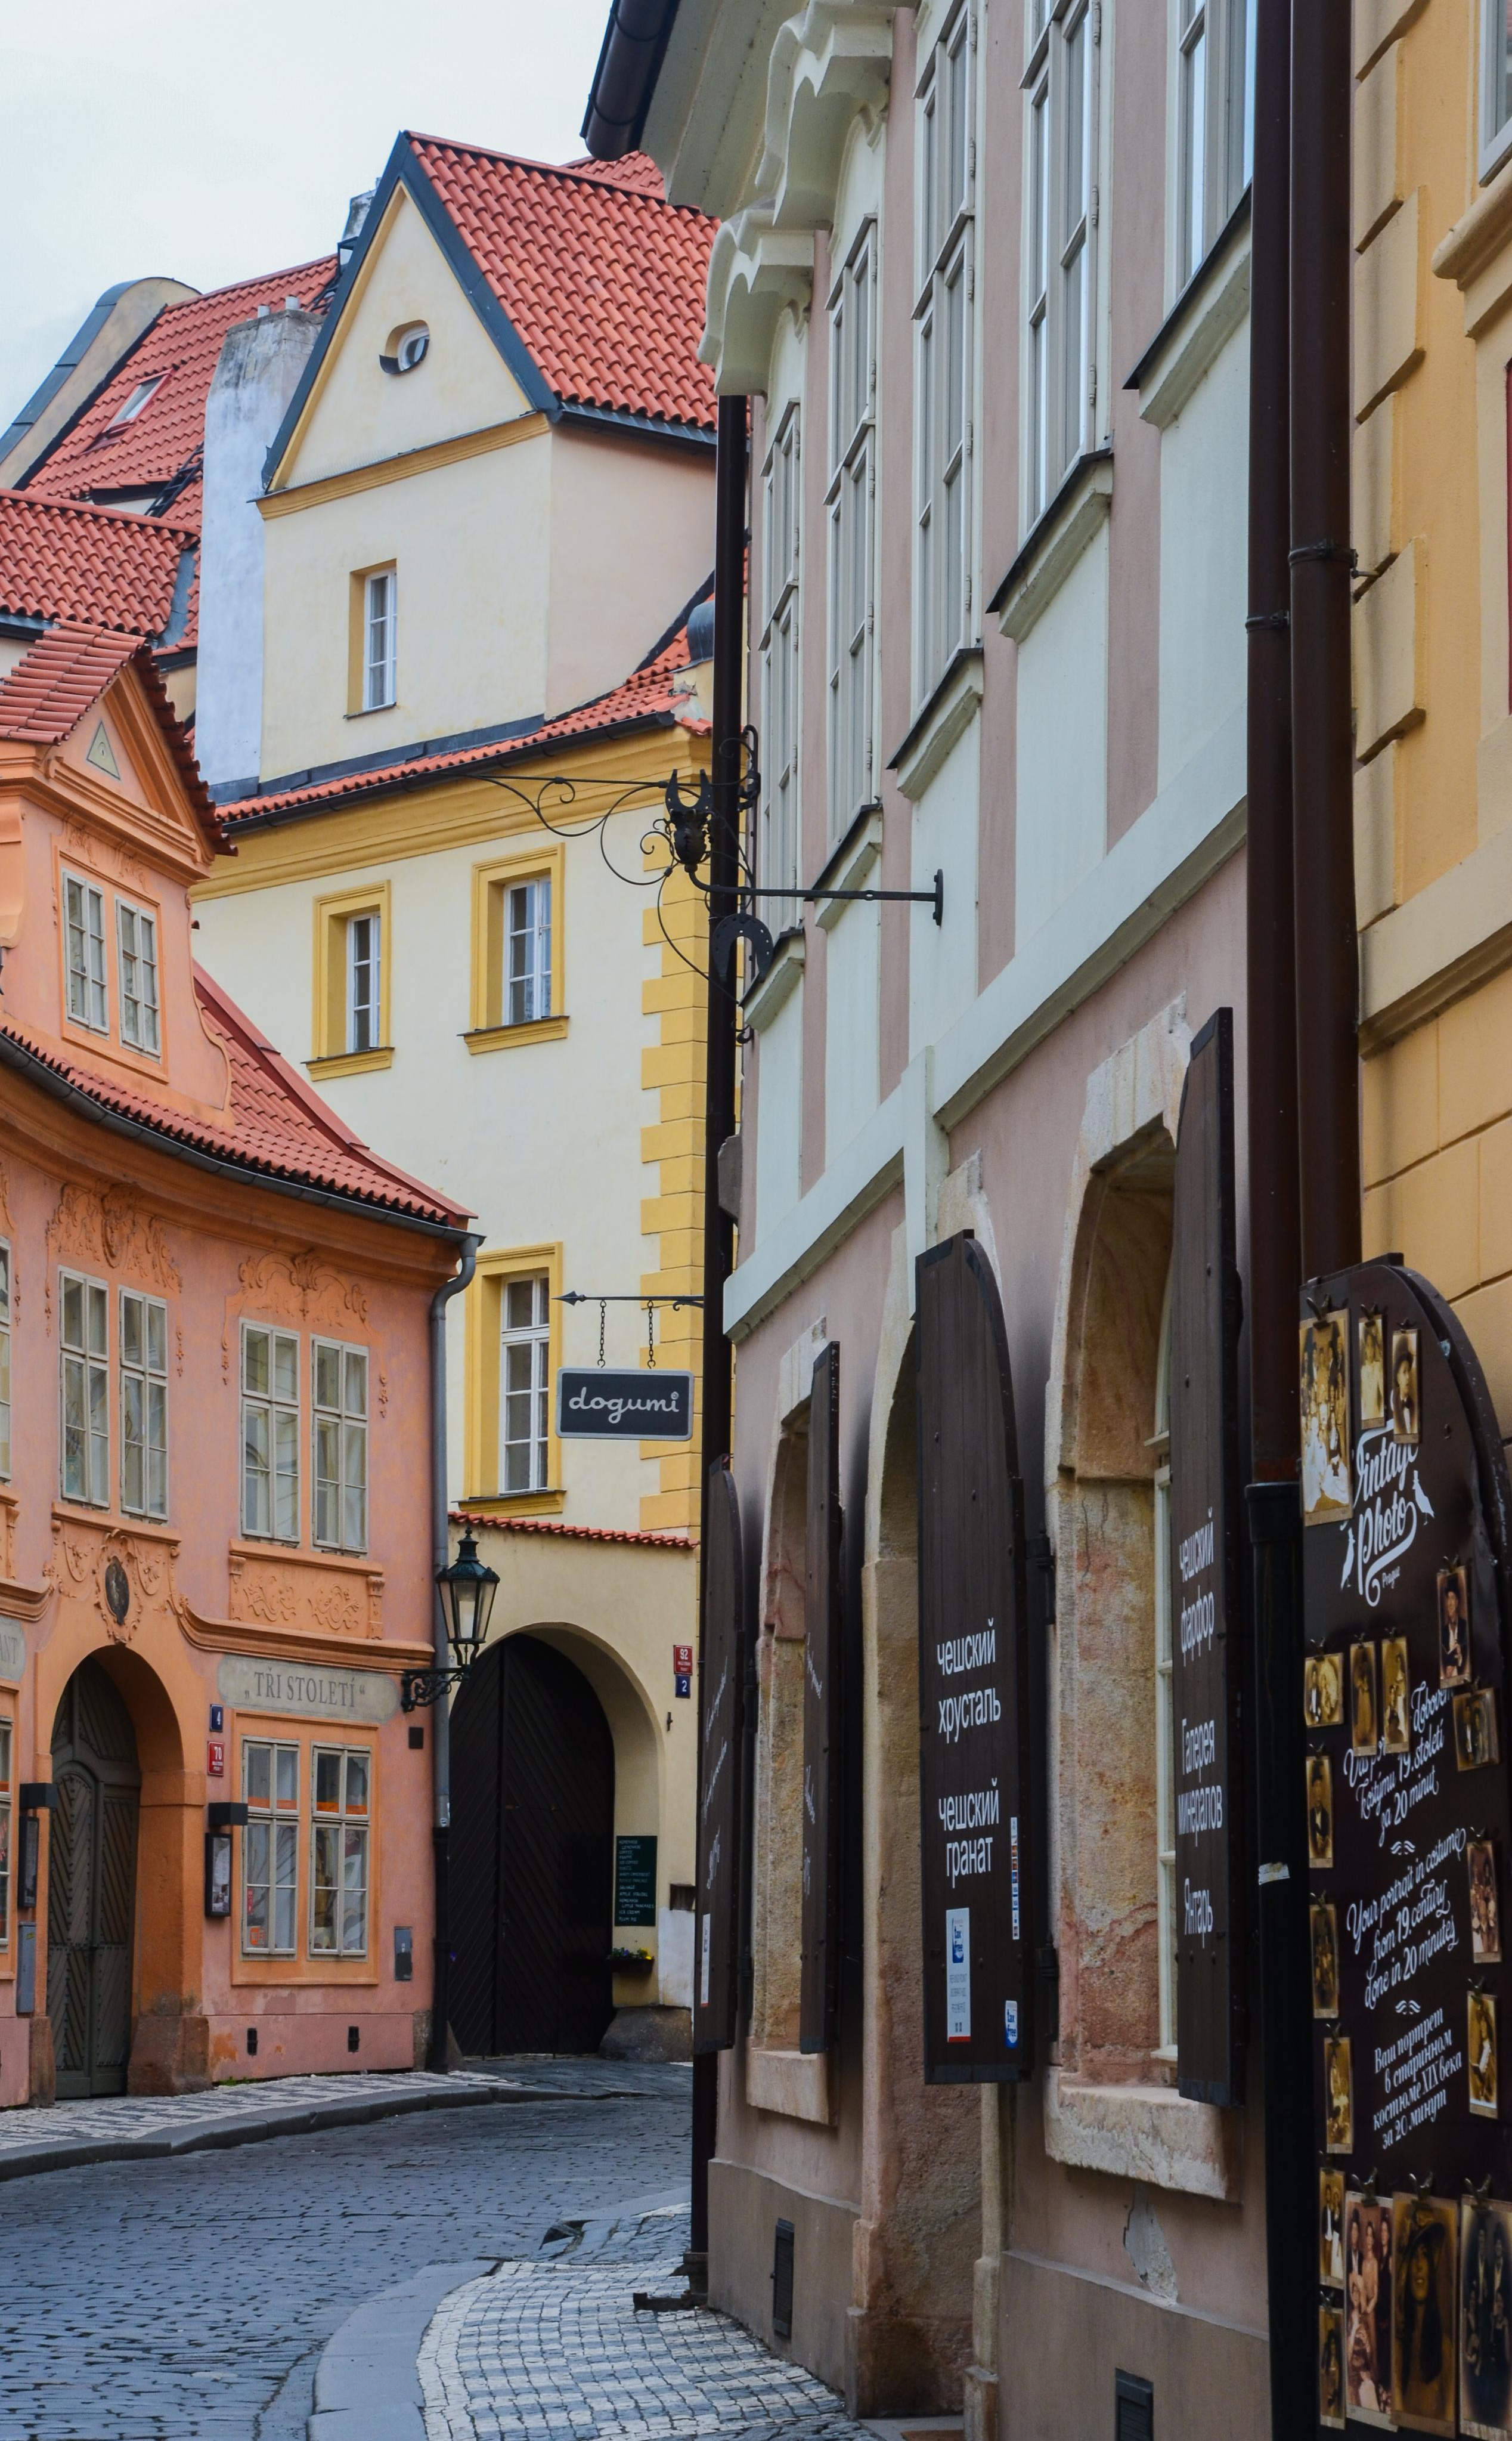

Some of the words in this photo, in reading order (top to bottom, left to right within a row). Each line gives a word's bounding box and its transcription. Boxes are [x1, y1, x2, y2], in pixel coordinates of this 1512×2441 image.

[569, 1387, 680, 1424] dogumi
[1179, 1506, 1214, 1583] чешский
[1358, 1490, 1417, 1607] Photo
[680, 1648, 689, 1660] 92
[937, 1617, 996, 1675] чешский
[1181, 1585, 1214, 1667] фарфор
[681, 1680, 687, 1692] 2
[938, 1688, 1002, 1744] хрусталь
[216, 1710, 221, 1725] 4
[1414, 1718, 1445, 1769] století
[214, 1746, 222, 1760] 70
[1182, 1718, 1215, 1783] Галерея
[938, 1777, 999, 1831] чешский
[1178, 1785, 1222, 1847] минералов
[1393, 1790, 1408, 1825] 20
[1409, 1765, 1439, 1808] minut
[946, 1837, 993, 1889] гранат
[1346, 1899, 1378, 1955] Your
[1380, 1865, 1414, 1929] portrait
[1415, 1858, 1424, 1883] in
[1426, 1828, 1466, 1873] costume
[1184, 1877, 1213, 1949] Янтарь
[1366, 1929, 1396, 1980] from
[1411, 1879, 1451, 1928] century
[1390, 1957, 1401, 1987] in
[1402, 1945, 1417, 1981] 20
[1418, 1914, 1459, 1966] minutes
[1375, 2044, 1396, 2074] Ваш
[1397, 2007, 1443, 2057] портрет
[1384, 2068, 1392, 2094] в
[1393, 2029, 1452, 2087] старинном
[1373, 2081, 1421, 2131] костюме
[1421, 2061, 1439, 2095] XIX
[1439, 2051, 1462, 2081] века
[1382, 2128, 1393, 2149] за
[1395, 2115, 1408, 2142] 20
[1408, 2089, 1446, 2131] минут
